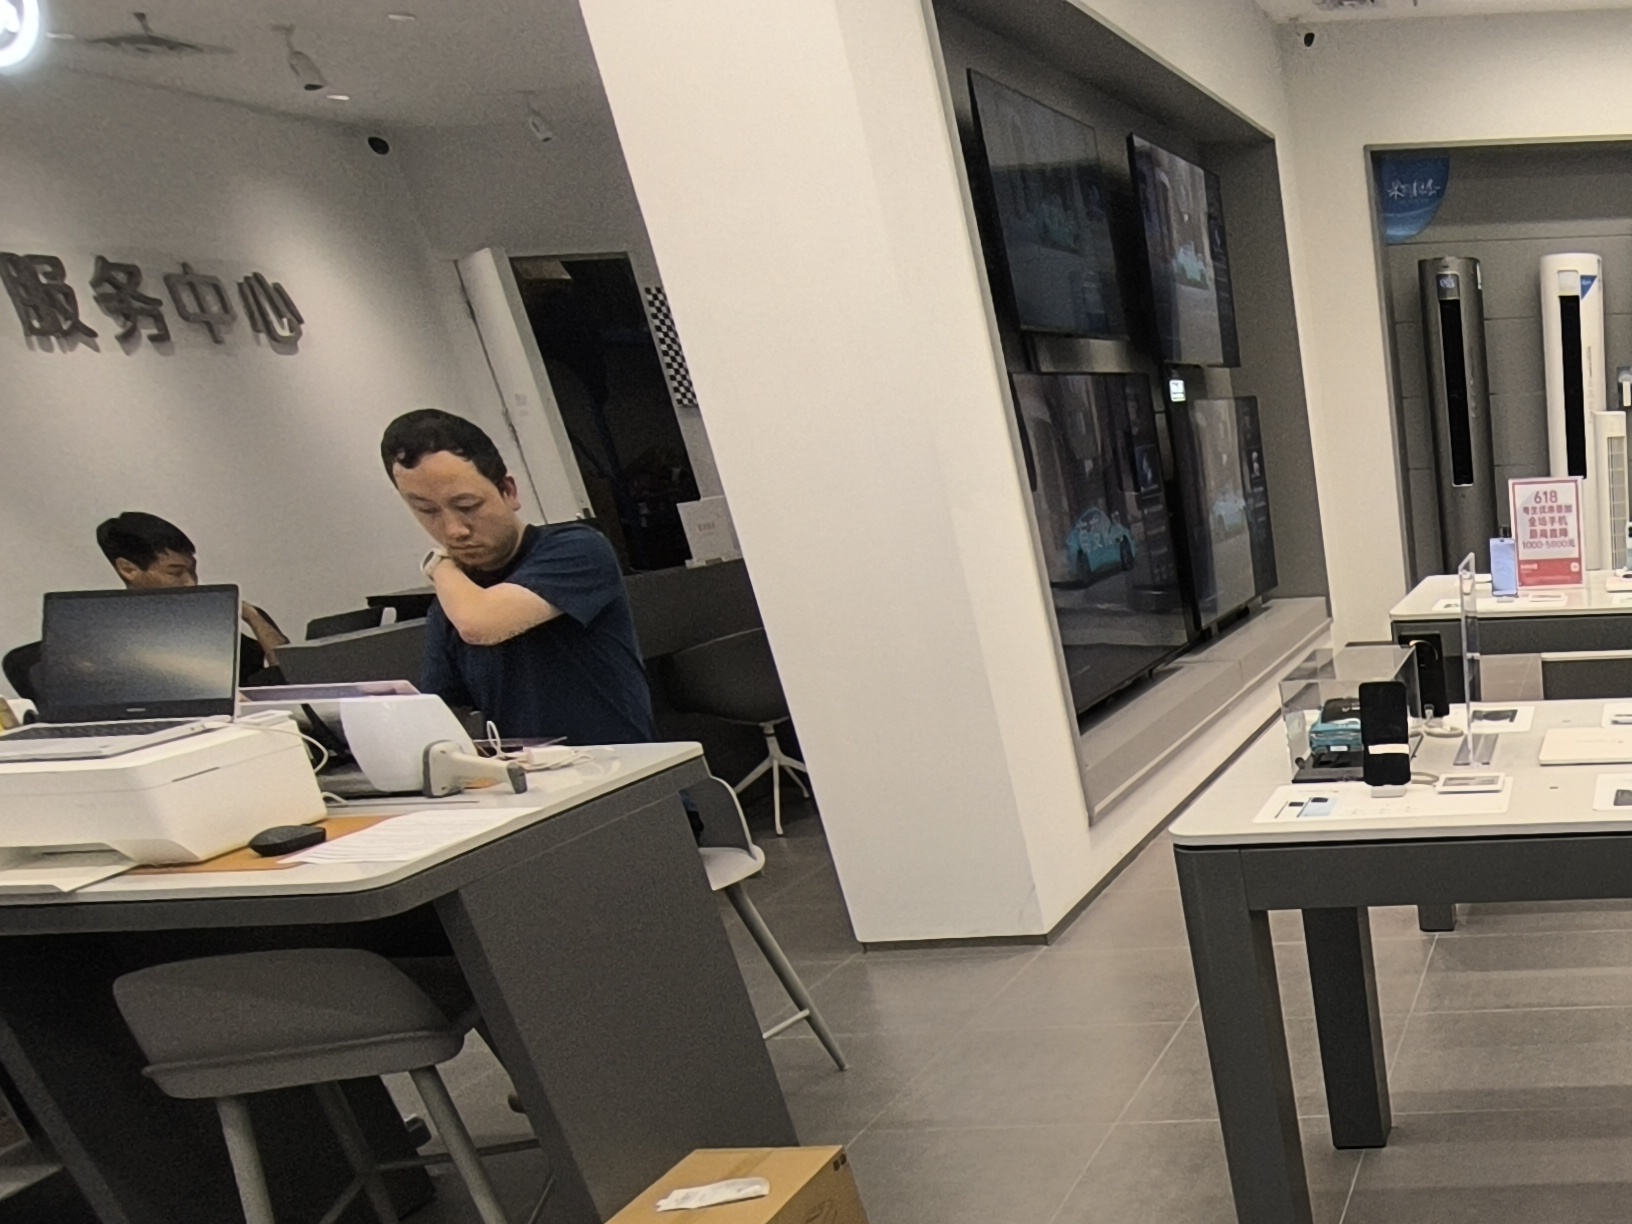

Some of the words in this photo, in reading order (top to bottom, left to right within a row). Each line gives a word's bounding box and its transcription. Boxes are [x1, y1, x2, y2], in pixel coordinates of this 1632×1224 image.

[0, 252, 304, 346] 服务中心
[1534, 490, 1558, 504] 618
